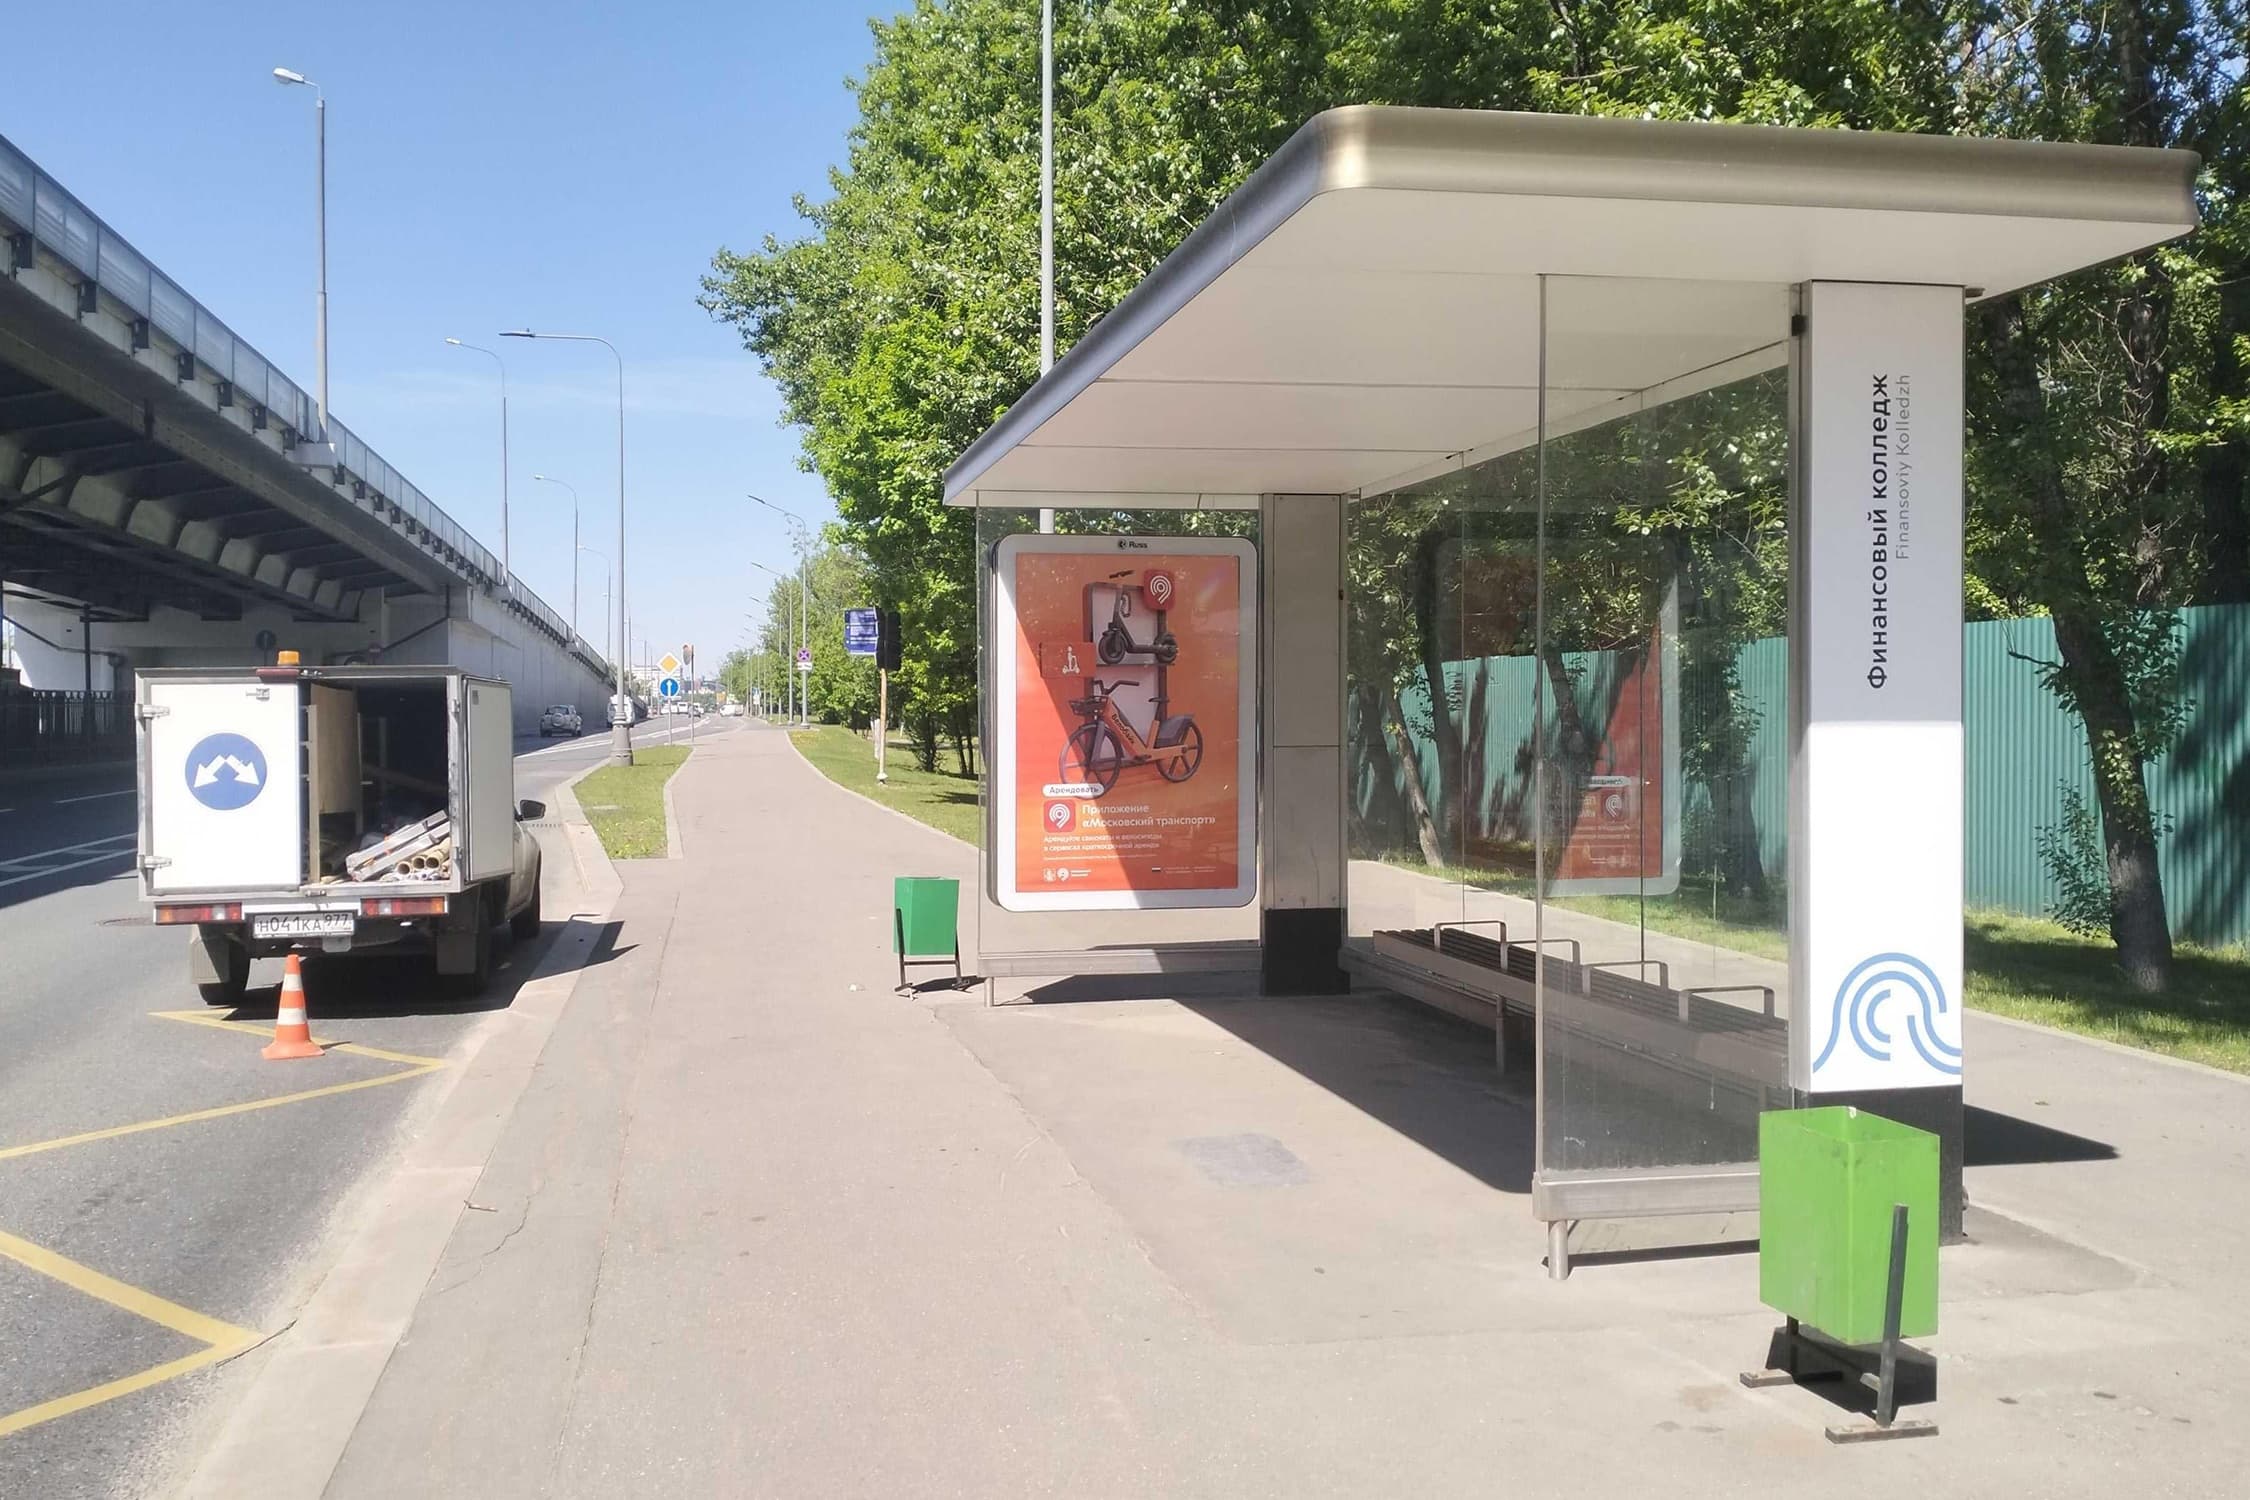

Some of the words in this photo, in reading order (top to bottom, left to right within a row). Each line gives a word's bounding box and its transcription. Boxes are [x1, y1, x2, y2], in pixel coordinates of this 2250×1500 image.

[1872, 374, 1891, 499] колледж
[1895, 374, 1910, 456] Kolledzh
[1895, 461, 1912, 560] Finansoviy
[1867, 508, 1888, 689] Финансовый
[1049, 785, 1099, 795] Арендовать
[1082, 804, 1150, 815] Приложение
